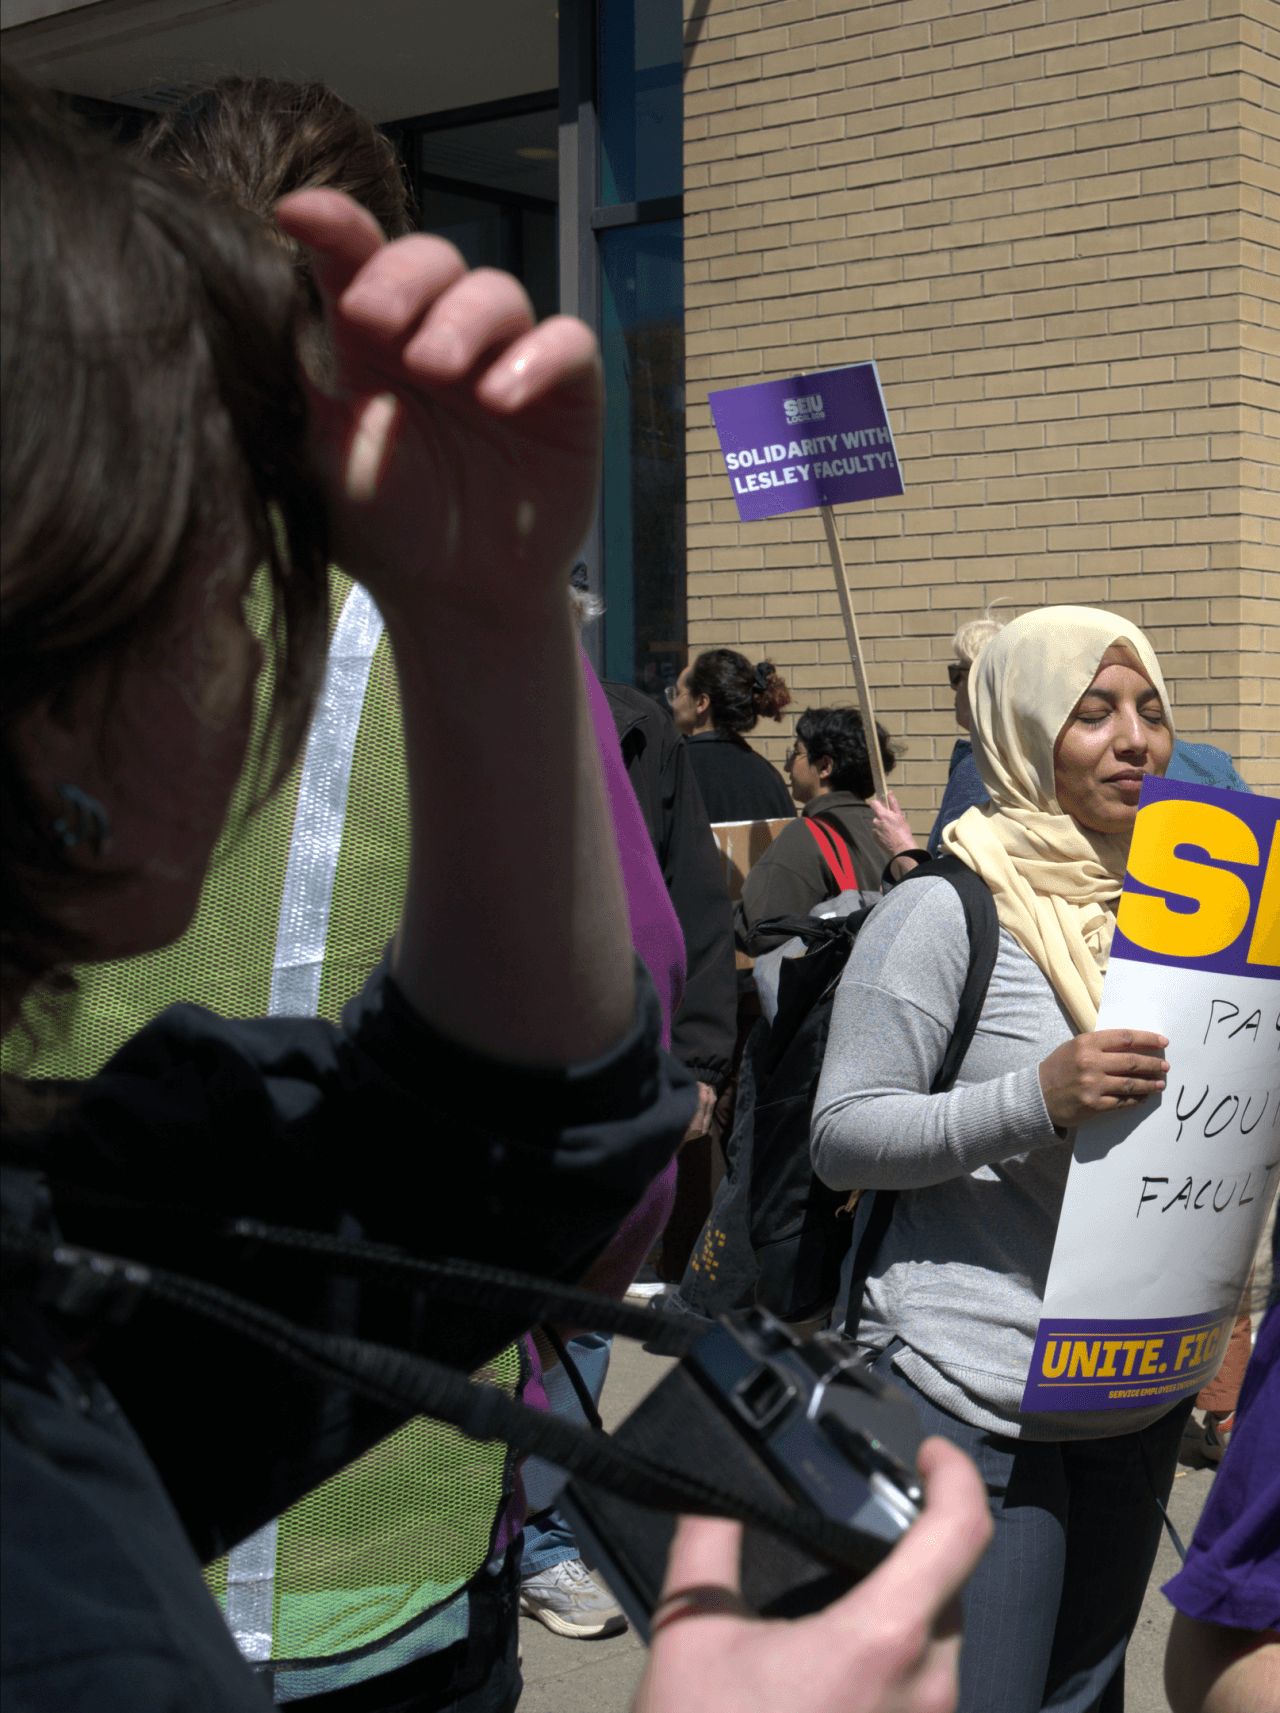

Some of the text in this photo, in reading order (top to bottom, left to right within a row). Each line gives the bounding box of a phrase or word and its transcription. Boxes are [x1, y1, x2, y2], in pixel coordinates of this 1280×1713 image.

[784, 395, 824, 417] SEIU
[725, 426, 891, 470] SOLIDARITY WITH
[734, 451, 895, 494] LESLEY FACULTY!
[1042, 1324, 1227, 1379] UNITE. FIG
[1108, 1388, 1140, 1399] SERVICE
